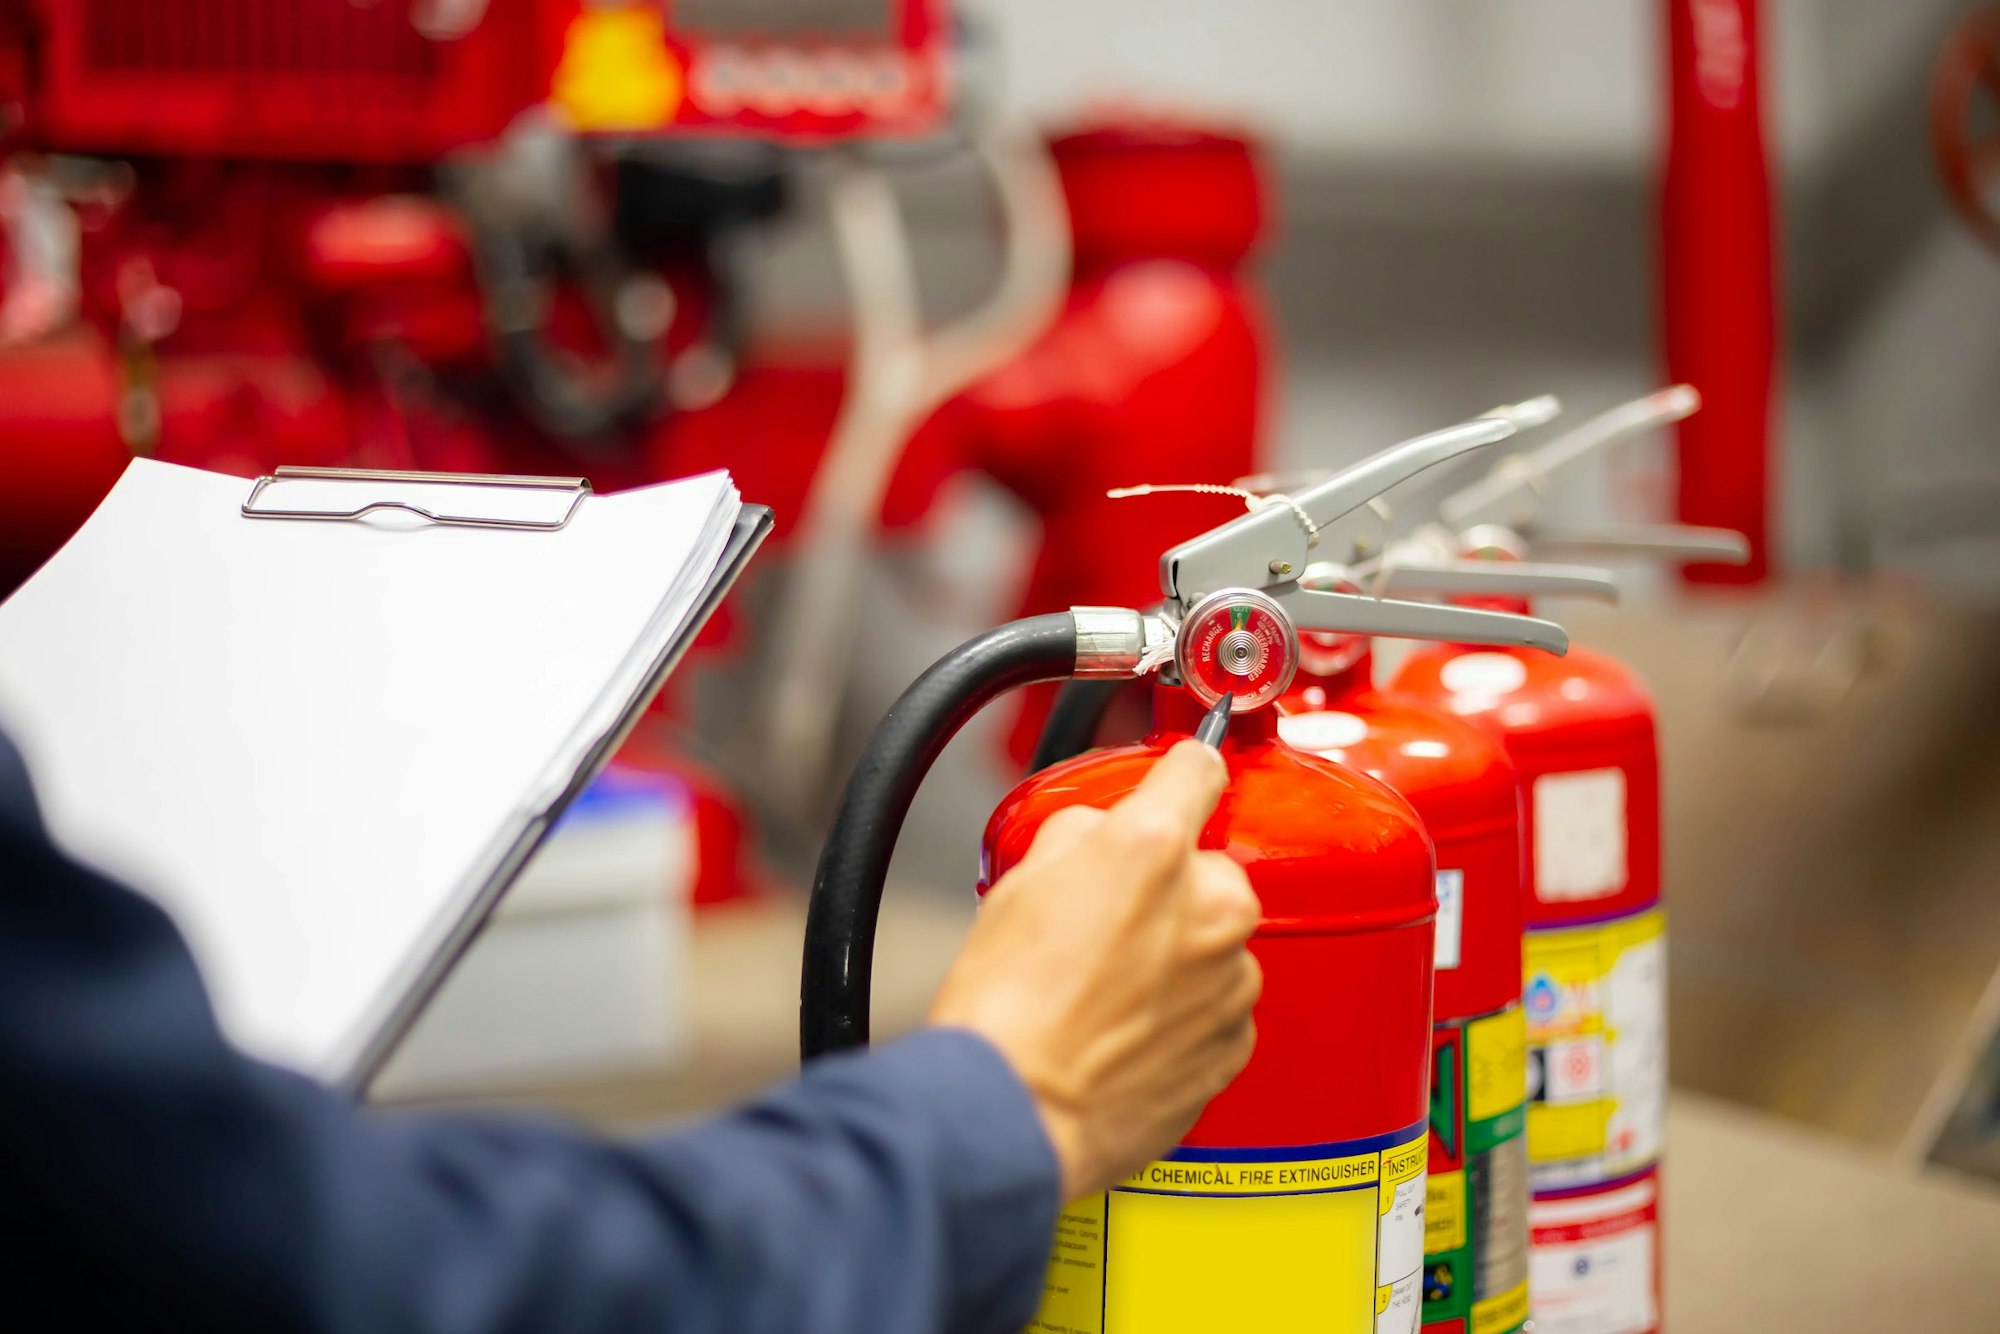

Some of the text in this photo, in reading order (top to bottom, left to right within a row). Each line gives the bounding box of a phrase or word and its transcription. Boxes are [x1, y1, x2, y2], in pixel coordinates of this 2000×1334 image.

[1202, 623, 1223, 662] RECHARGE
[1247, 628, 1270, 682] OVERCHARGED
[1151, 1167, 1234, 1185] CHEMICAL
[1239, 1170, 1274, 1185] FIRE
[1279, 1160, 1375, 1184] EXTINGUISHER
